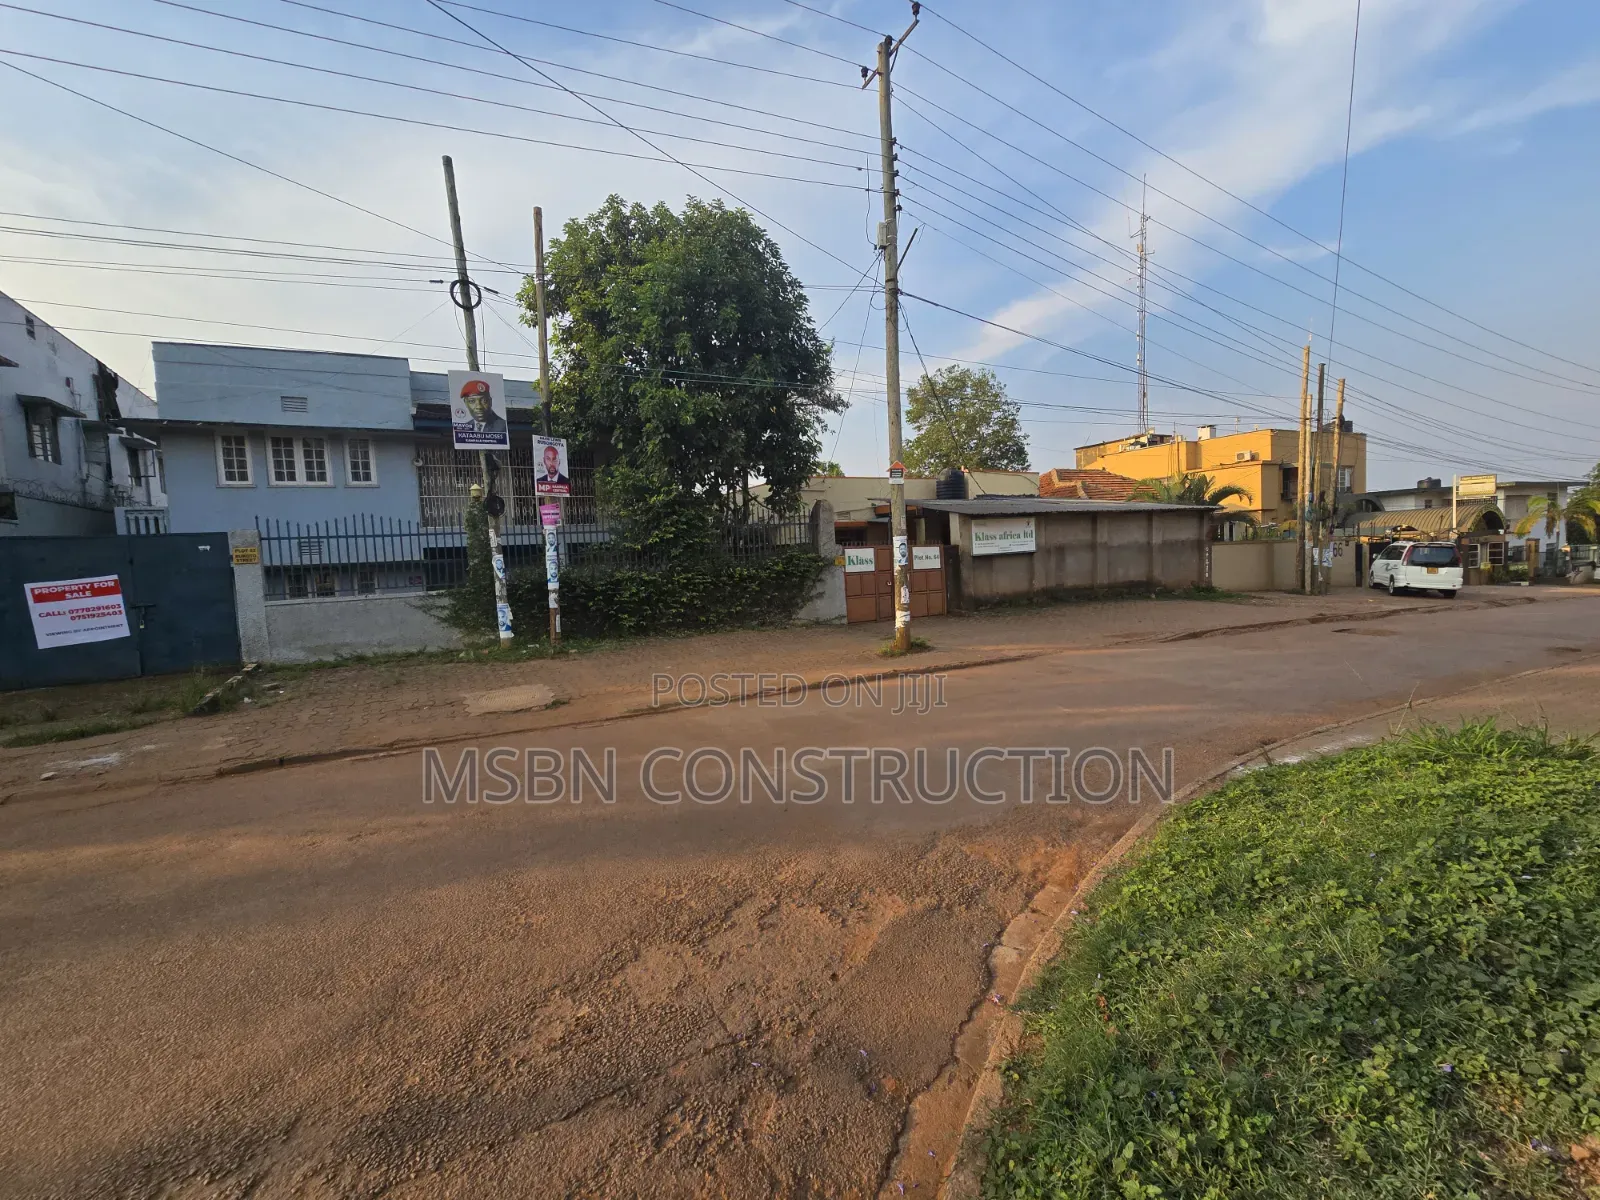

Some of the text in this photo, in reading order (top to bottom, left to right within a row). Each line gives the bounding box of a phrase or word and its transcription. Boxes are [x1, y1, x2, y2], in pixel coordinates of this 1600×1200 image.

[975, 529, 1034, 541] Klass africa ltd
[1333, 543, 1343, 557] 66
[847, 555, 873, 566] Klass
[34, 580, 115, 594] PROPERTY FOR
[64, 590, 92, 599] SALE
[38, 610, 66, 618] CALL:
